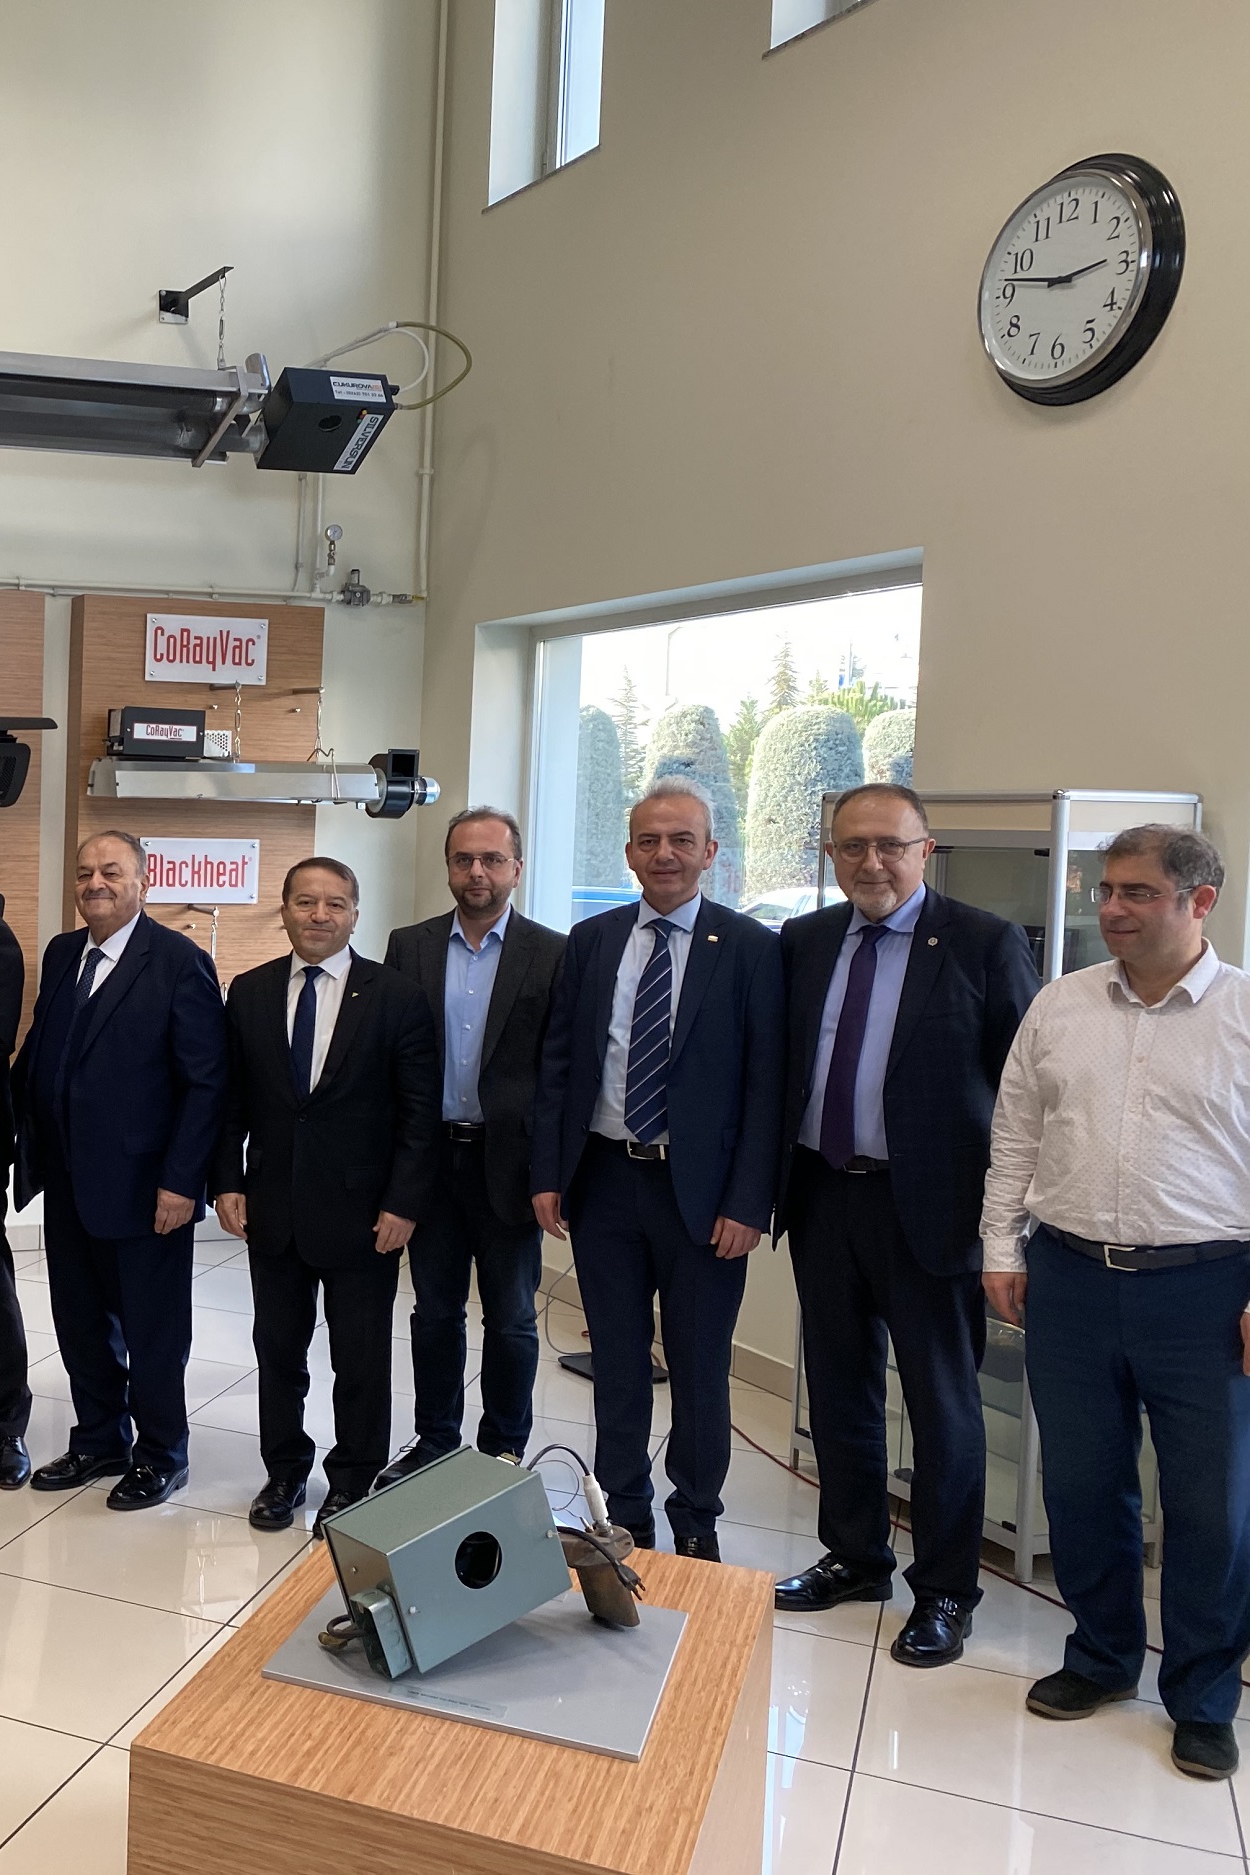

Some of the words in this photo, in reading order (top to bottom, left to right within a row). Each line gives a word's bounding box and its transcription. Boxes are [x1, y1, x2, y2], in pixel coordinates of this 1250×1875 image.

[1056, 198, 1080, 225] 12
[1090, 200, 1099, 225] 1
[1032, 216, 1052, 243] 11
[1106, 216, 1121, 241] 2
[1011, 248, 1034, 275] 10
[1115, 250, 1130, 275] 3
[1002, 282, 1016, 309] 9
[1102, 287, 1117, 312] 4
[1006, 314, 1021, 338] 8
[1082, 318, 1096, 343] 5
[1027, 332, 1041, 356] 7
[1050, 333, 1066, 360] 6
[341, 416, 379, 469] SILVERSUN
[153, 626, 256, 672] CoRayVac
[146, 724, 182, 738] CoRayVac
[147, 853, 249, 888] Blackheat
